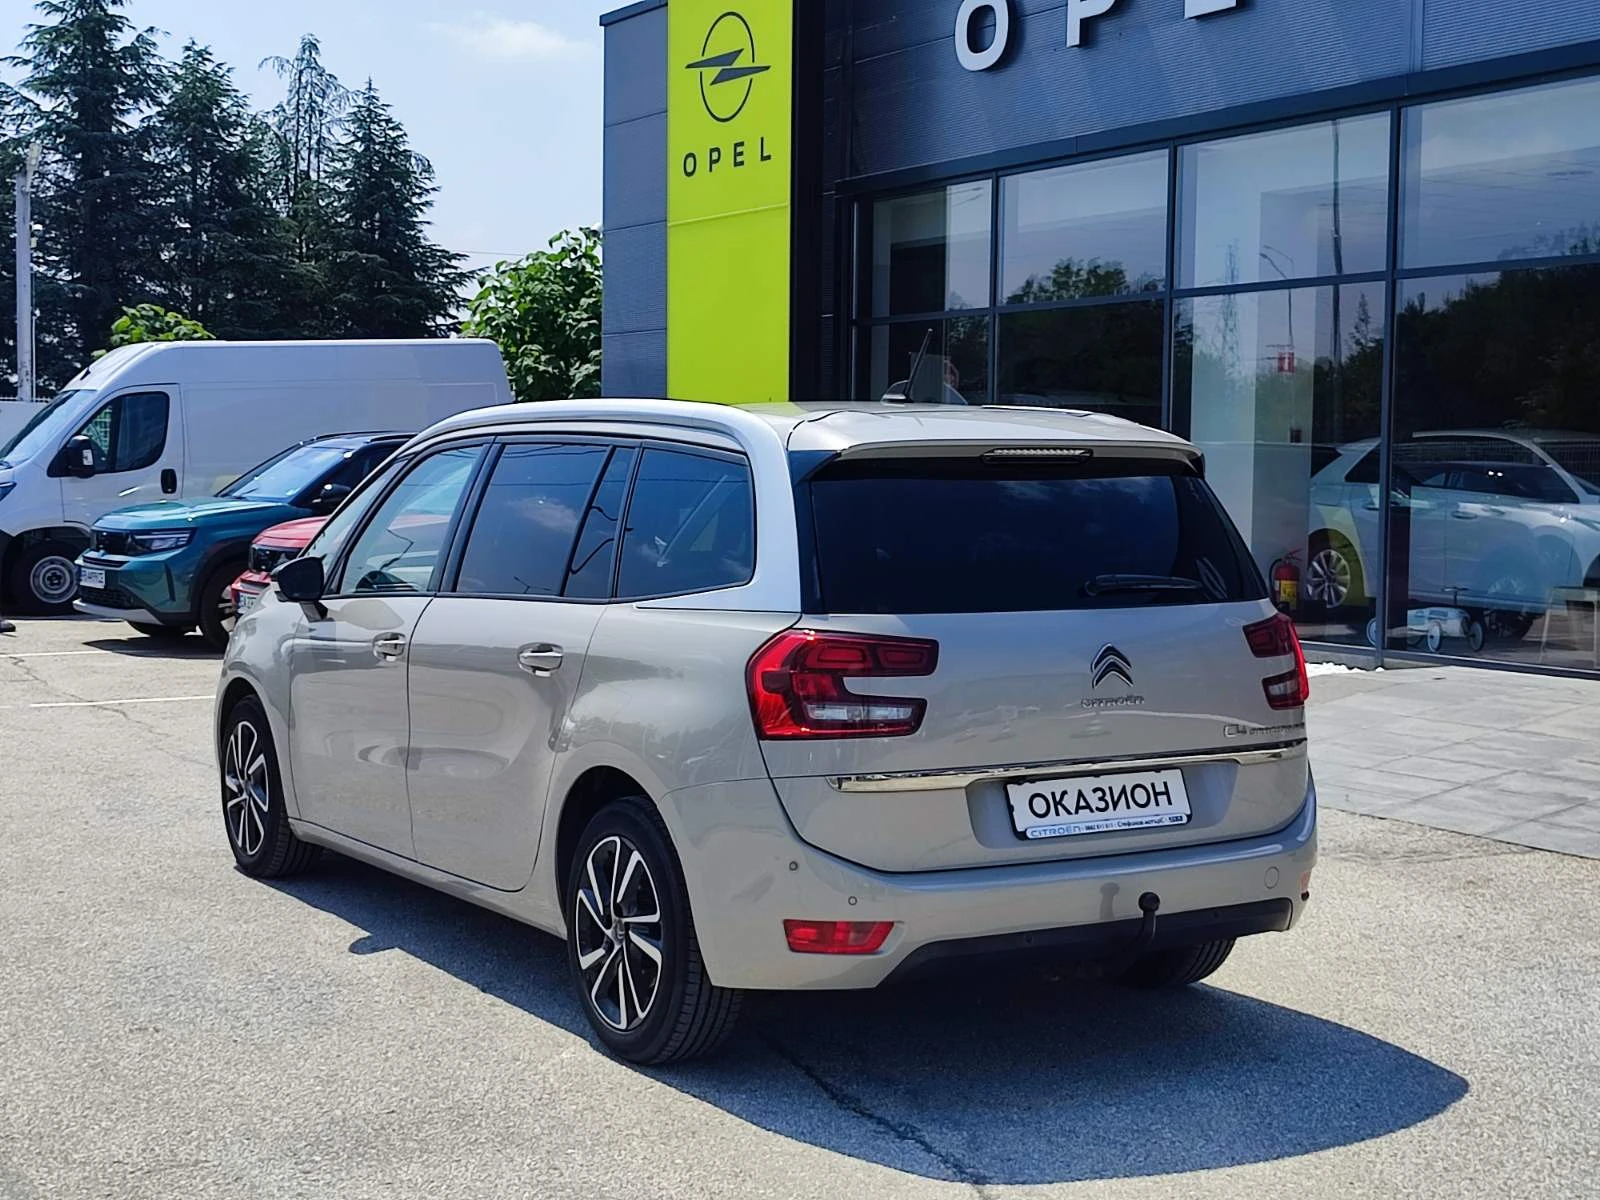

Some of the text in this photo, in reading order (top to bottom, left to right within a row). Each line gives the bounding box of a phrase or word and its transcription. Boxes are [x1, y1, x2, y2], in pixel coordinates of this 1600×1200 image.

[955, 0, 1237, 71] OP
[682, 136, 773, 178] OPEL
[1028, 781, 1173, 818] ОКАЗИОН
